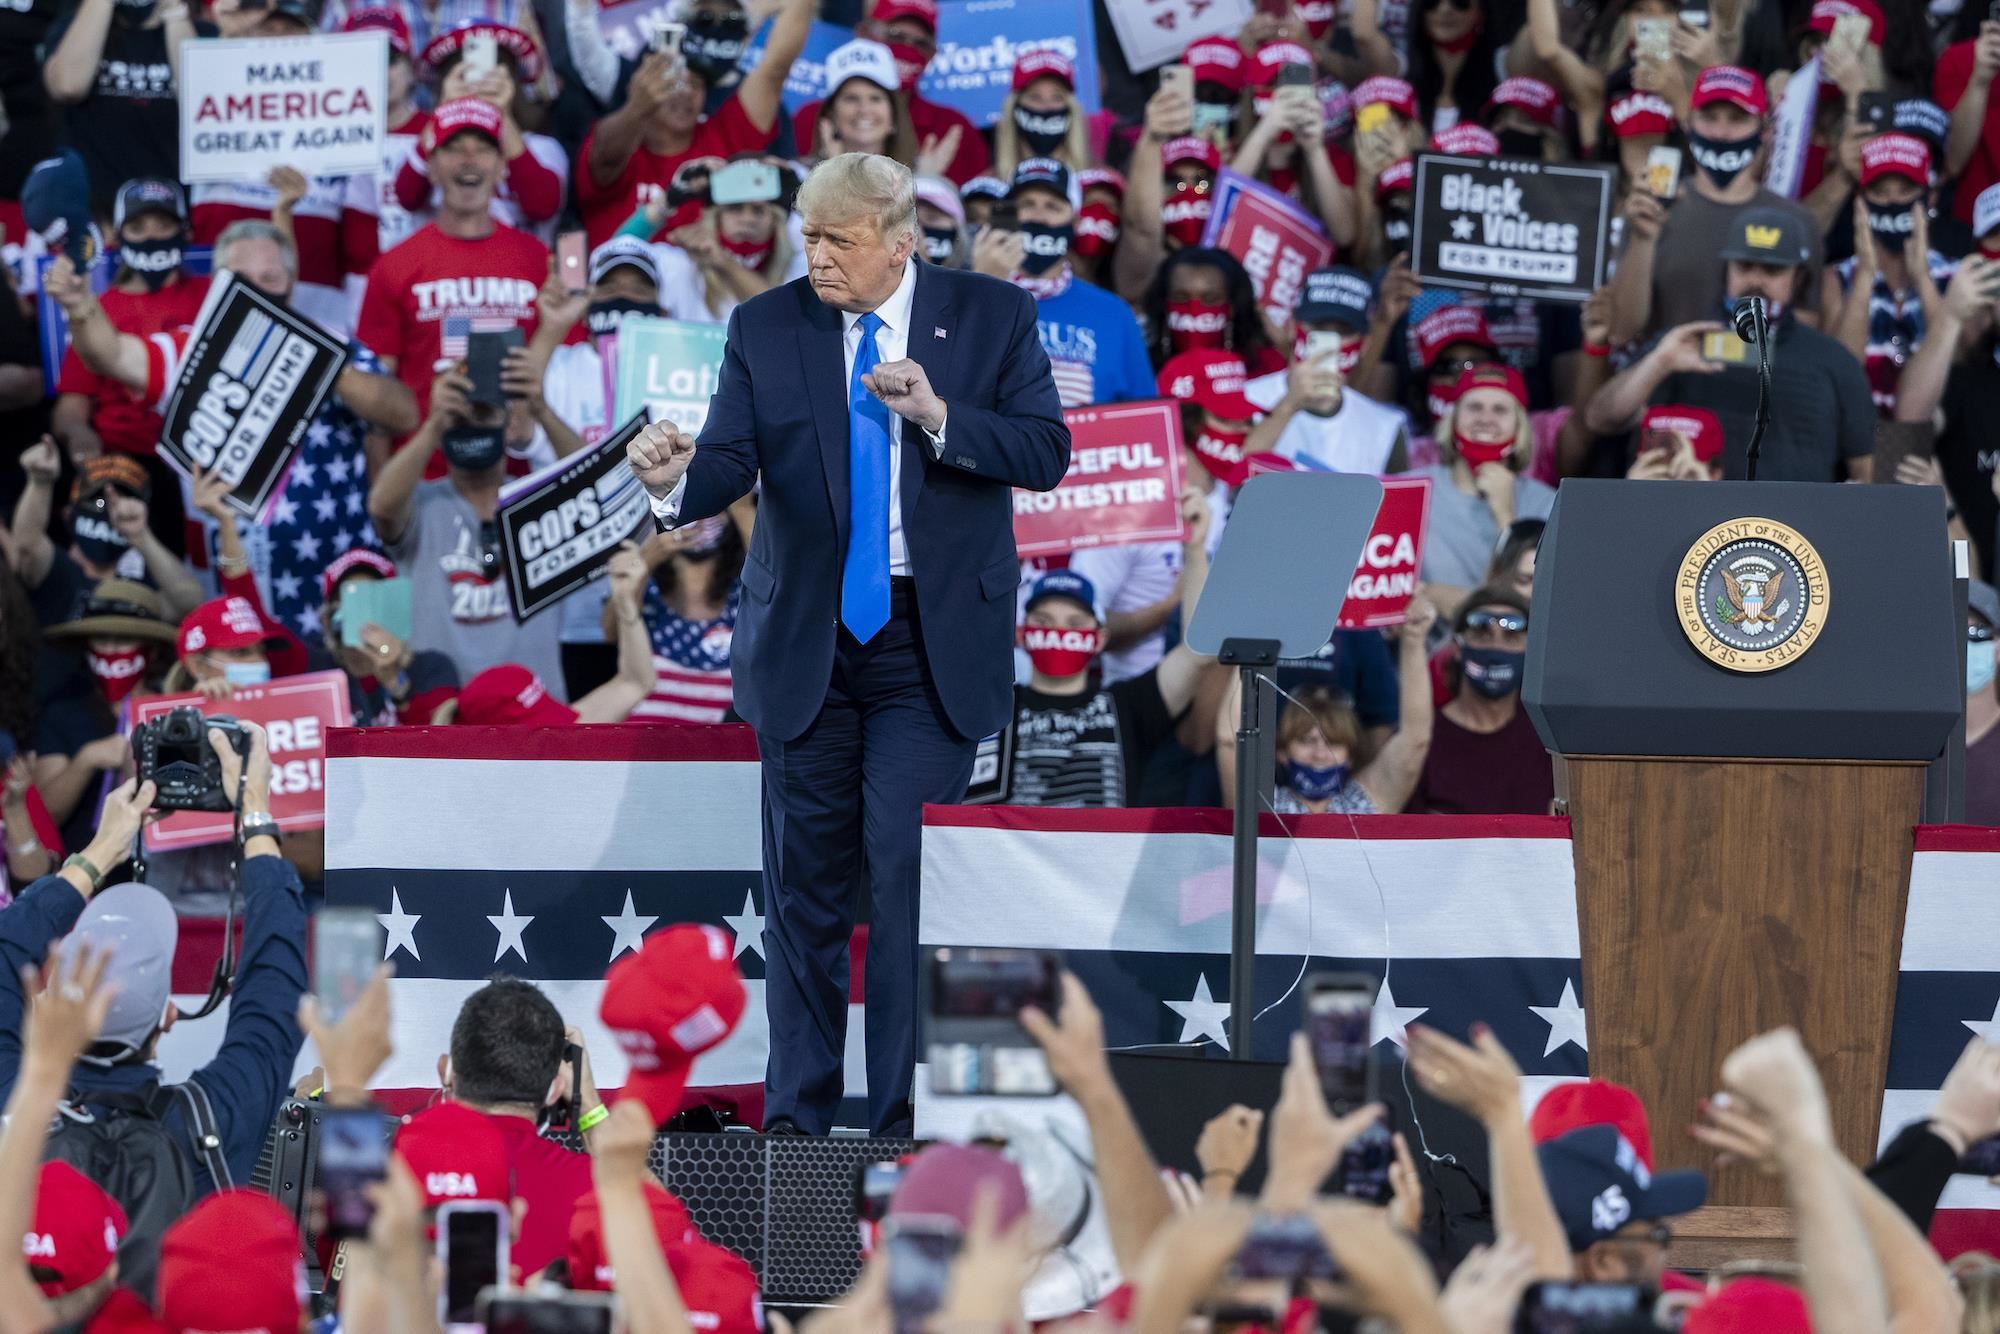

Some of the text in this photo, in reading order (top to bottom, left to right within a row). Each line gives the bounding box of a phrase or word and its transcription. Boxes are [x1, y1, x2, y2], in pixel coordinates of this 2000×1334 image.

[246, 60, 324, 85] MAKE
[838, 52, 879, 68] USA
[194, 88, 372, 124] AMERICA
[193, 126, 375, 155] GREAT AGAIN
[1440, 173, 1523, 215] Black
[1482, 211, 1579, 252] Voices
[1449, 251, 1568, 275] FOR TRUMP
[411, 276, 538, 310] TRUMP
[182, 371, 251, 468] COPS
[221, 341, 308, 477] FOR TRUMP
[518, 487, 601, 561] COPS
[532, 547, 577, 577] FOR
[1681, 523, 1824, 665] SEAL OF THE PRESIDENT OF THE UNITED STATES
[426, 1171, 478, 1196] USA
[1591, 1183, 1631, 1231] 45
[331, 1241, 349, 1281] EOS
